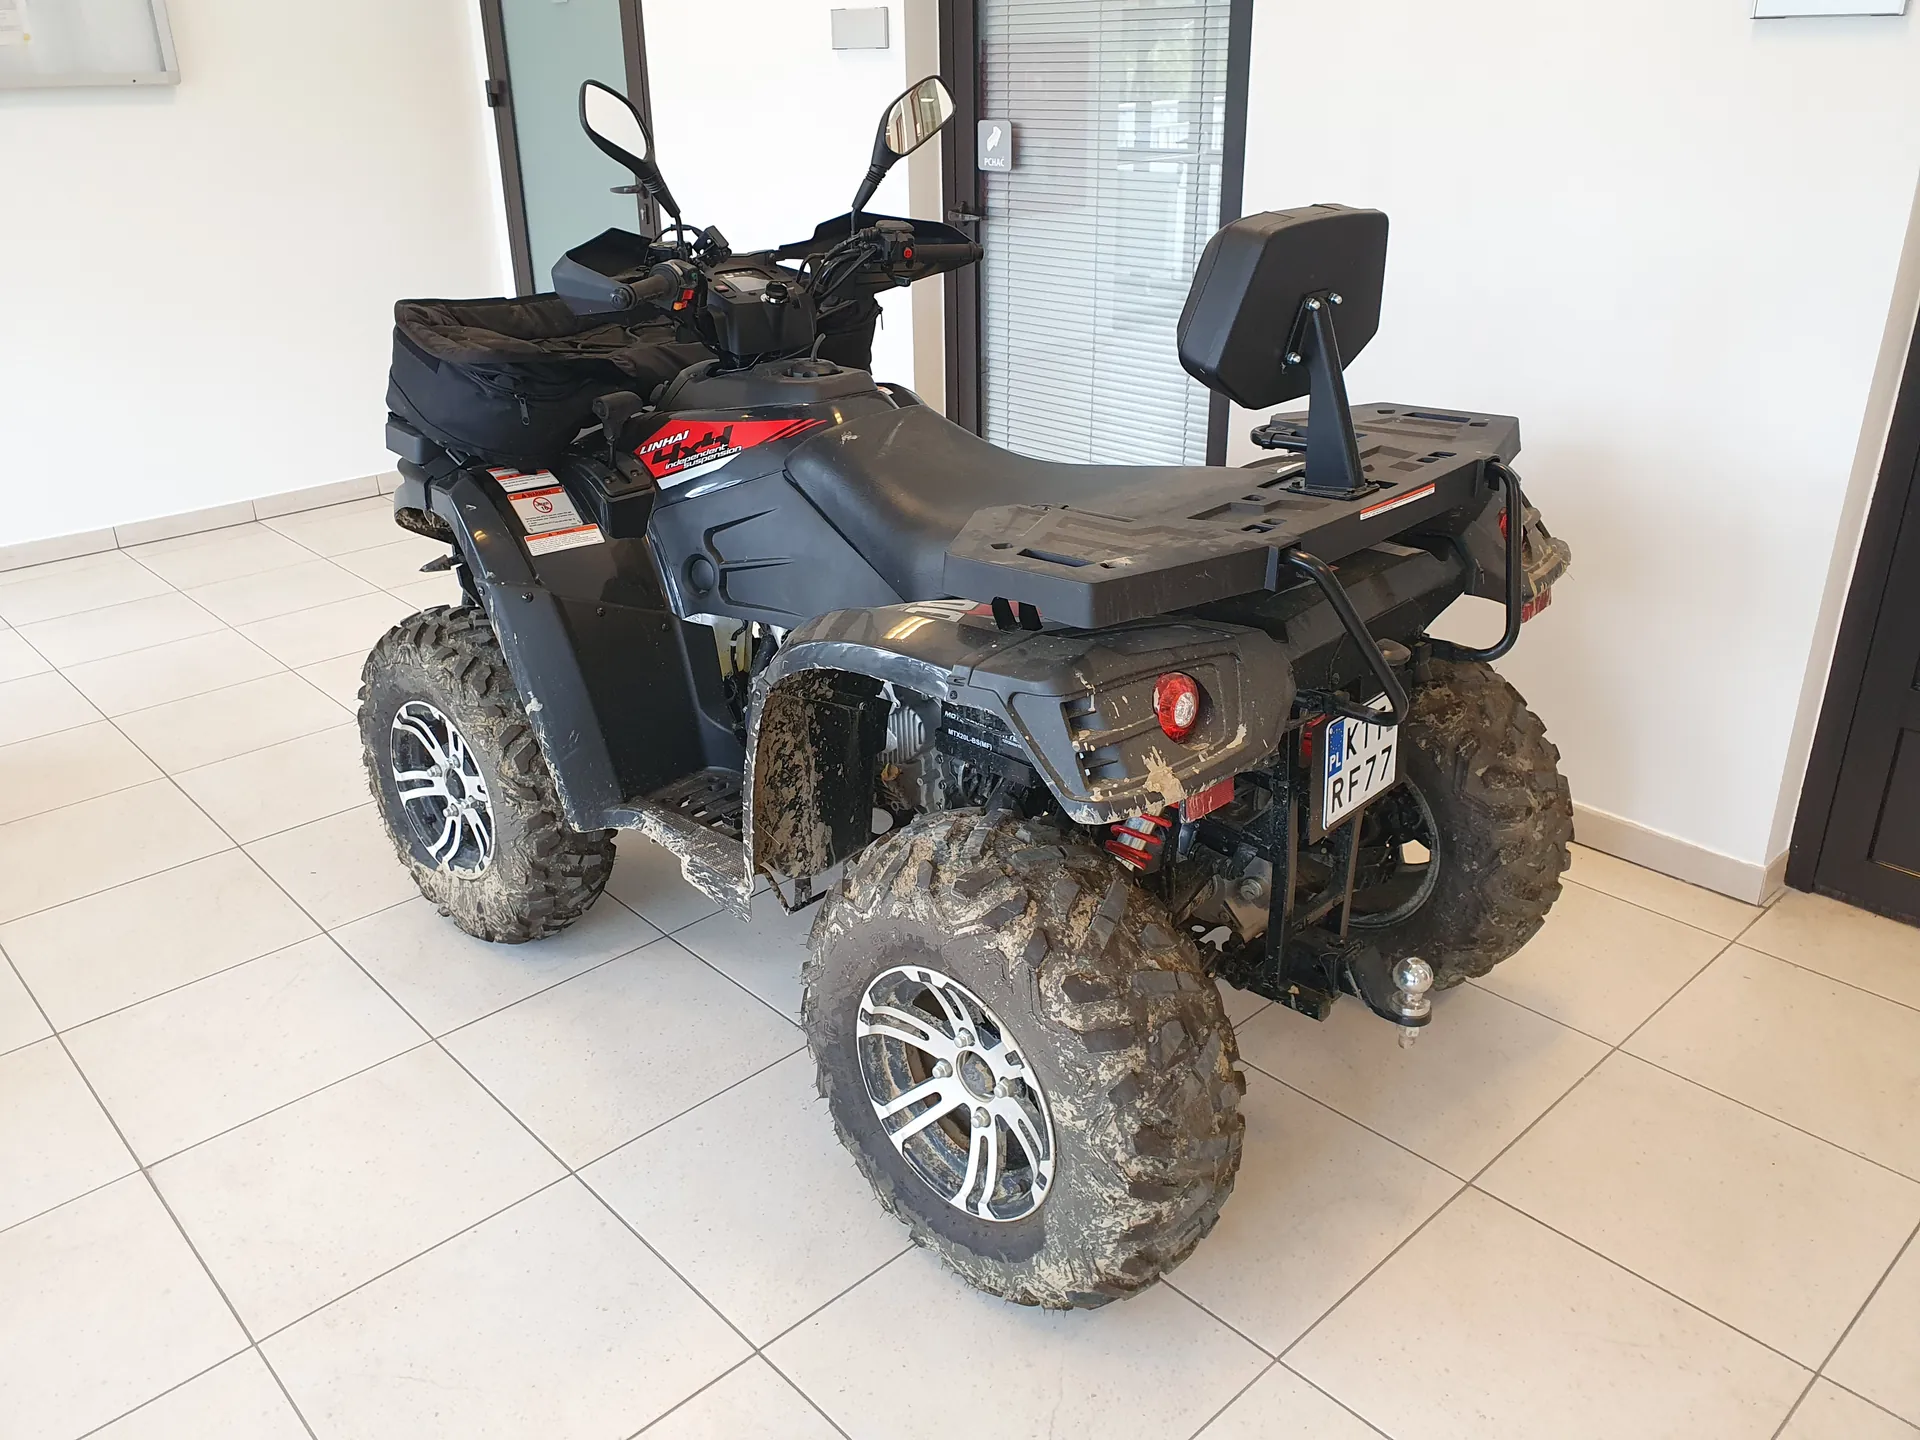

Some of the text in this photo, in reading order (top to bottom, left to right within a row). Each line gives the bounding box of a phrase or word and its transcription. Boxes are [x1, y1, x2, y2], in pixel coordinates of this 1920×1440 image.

[639, 429, 690, 455] LINHAI
[665, 443, 728, 470] independent
[683, 445, 742, 469] suspension
[1329, 751, 1341, 772] PL
[1331, 744, 1393, 814] RF77
